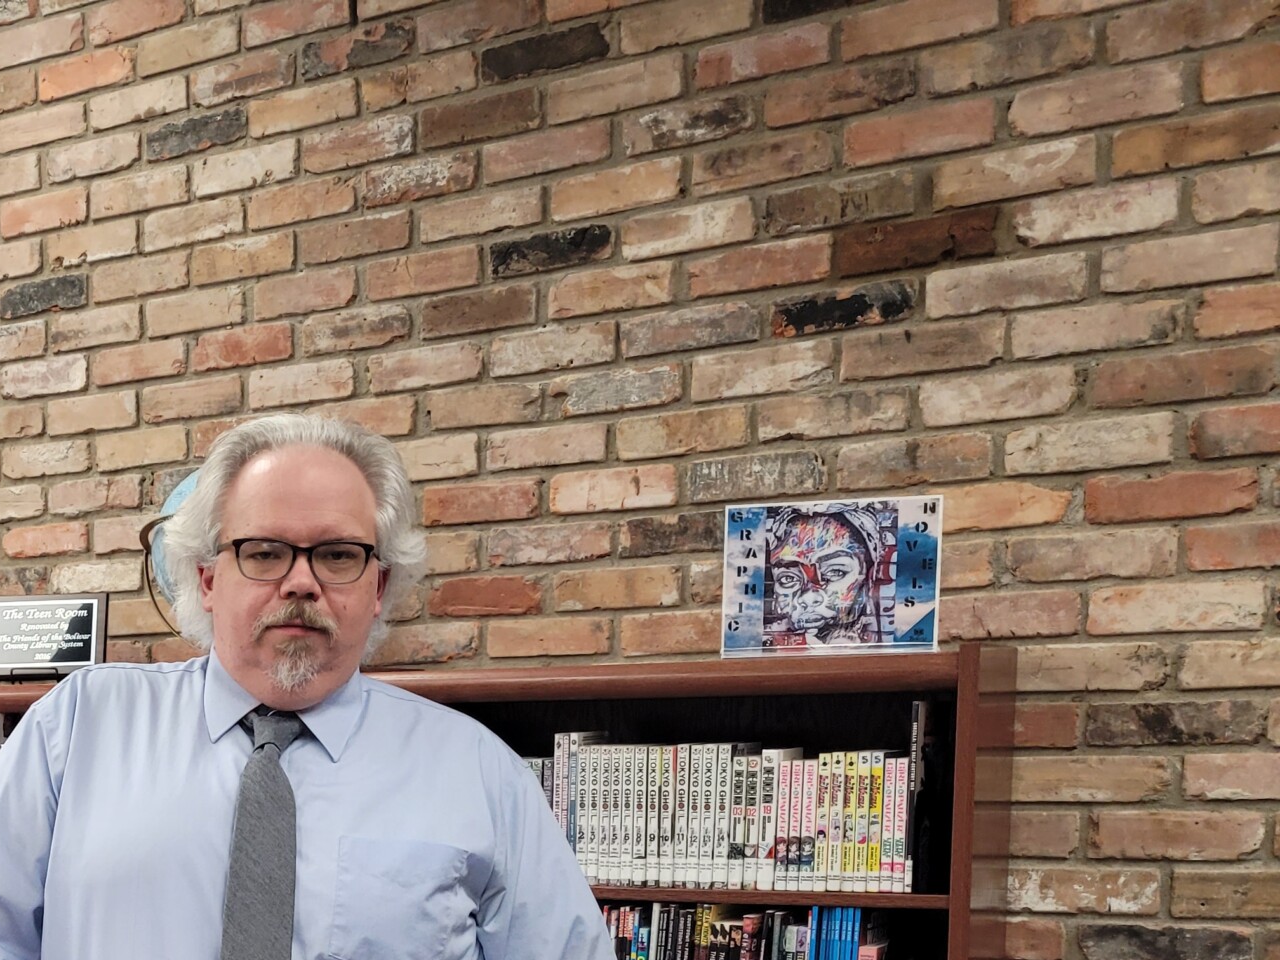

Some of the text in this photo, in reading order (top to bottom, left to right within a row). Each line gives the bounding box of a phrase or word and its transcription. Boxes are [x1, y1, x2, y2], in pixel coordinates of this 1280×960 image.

[2, 607, 88, 620] The Teen Room
[3, 641, 84, 651] County Library System
[13, 633, 40, 643] Friends
[41, 633, 51, 642] of
[19, 621, 70, 632] Renovated by
[578, 755, 587, 822] TOKYO GHOUL
[590, 755, 599, 823] TOKYO GHOUL
[601, 757, 611, 823] TOKYO GHOUL
[612, 755, 621, 823] TOKYO GHOUL
[623, 755, 632, 823] TOKYO GHOUL
[635, 756, 645, 824] TOKYO GHOUL
[649, 756, 657, 824] TOKYO GHOUL
[661, 756, 670, 824] TOKYO GHOUL
[677, 754, 686, 822] TOKYO GHOUL
[691, 756, 700, 824] TOKYO GHOUL
[704, 755, 713, 824] TOKYO GHOUL
[719, 755, 728, 824] TOKYO GHOUL
[732, 807, 743, 816] 03
[746, 808, 756, 816] 02
[762, 805, 772, 814] 19
[578, 832, 585, 840] 2
[648, 833, 656, 842] 9
